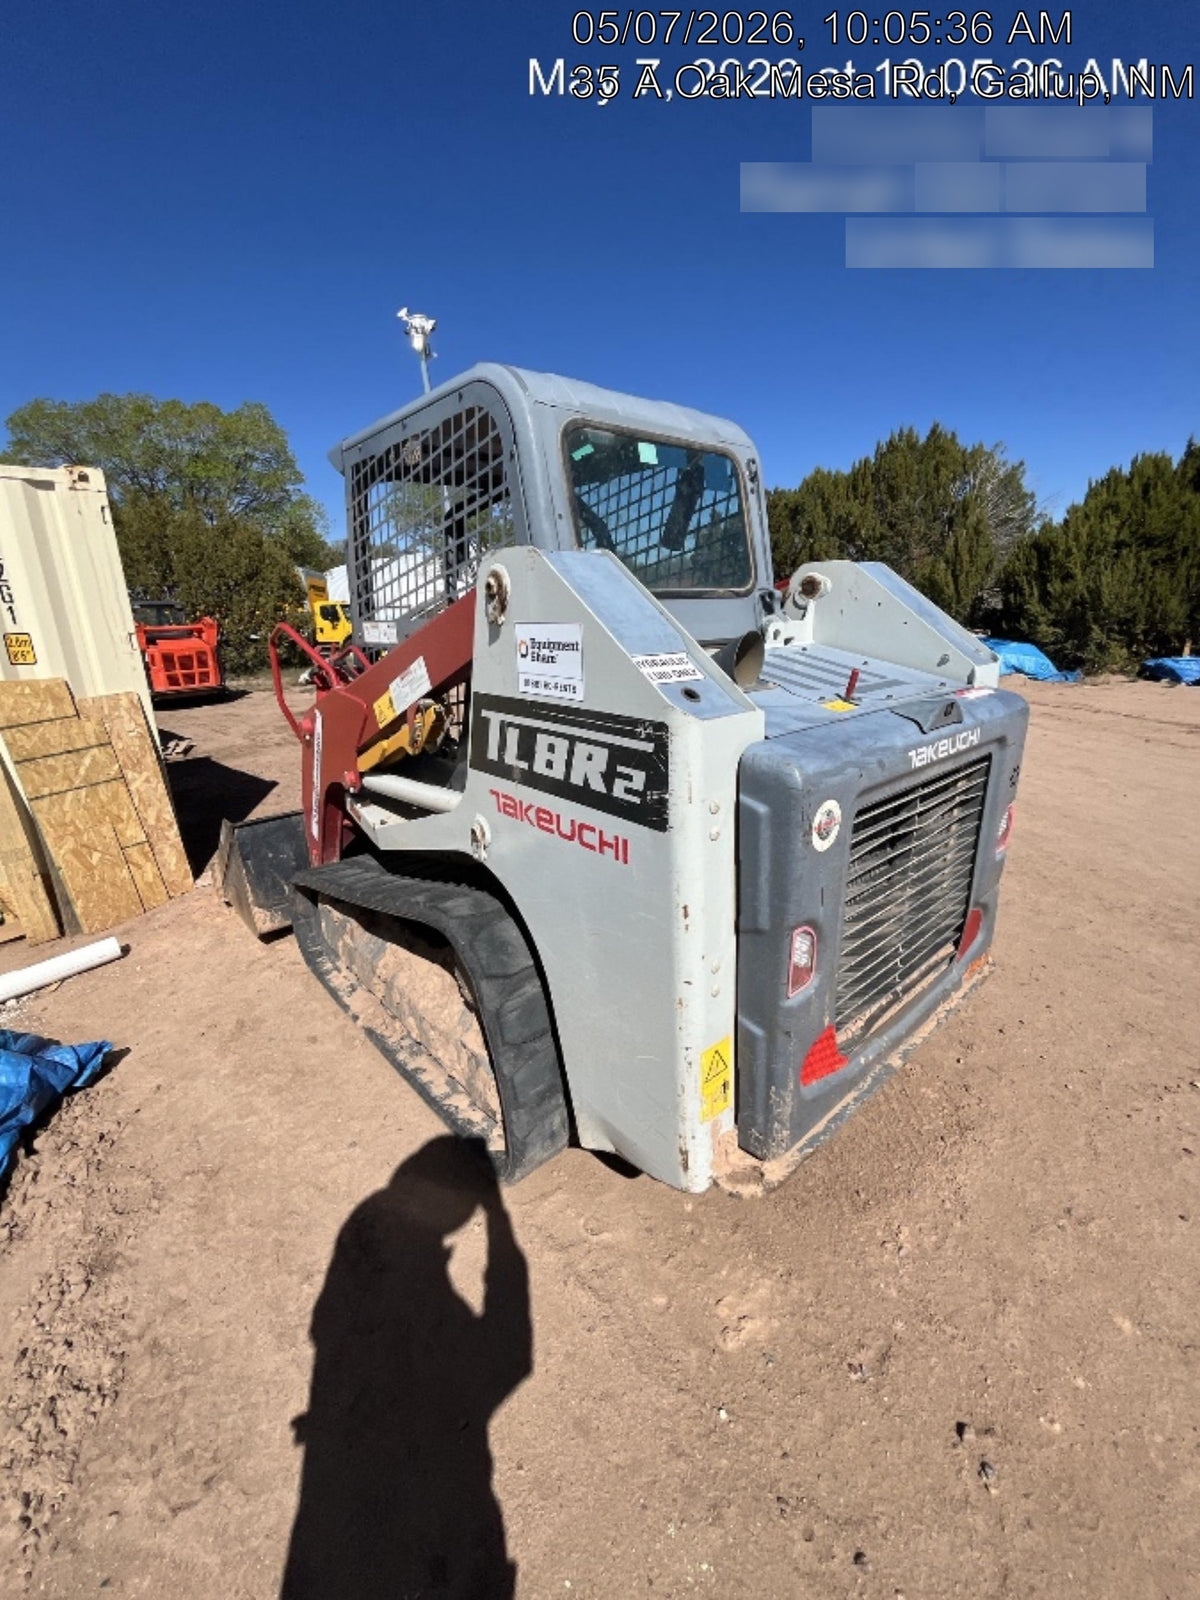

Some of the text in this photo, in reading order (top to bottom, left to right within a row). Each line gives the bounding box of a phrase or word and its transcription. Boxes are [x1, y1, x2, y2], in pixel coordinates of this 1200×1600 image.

[0, 558, 17, 624] 2G1
[529, 637, 579, 653] Equipment
[481, 709, 655, 804] TL8R2
[489, 788, 630, 865] TAKEUCHI
